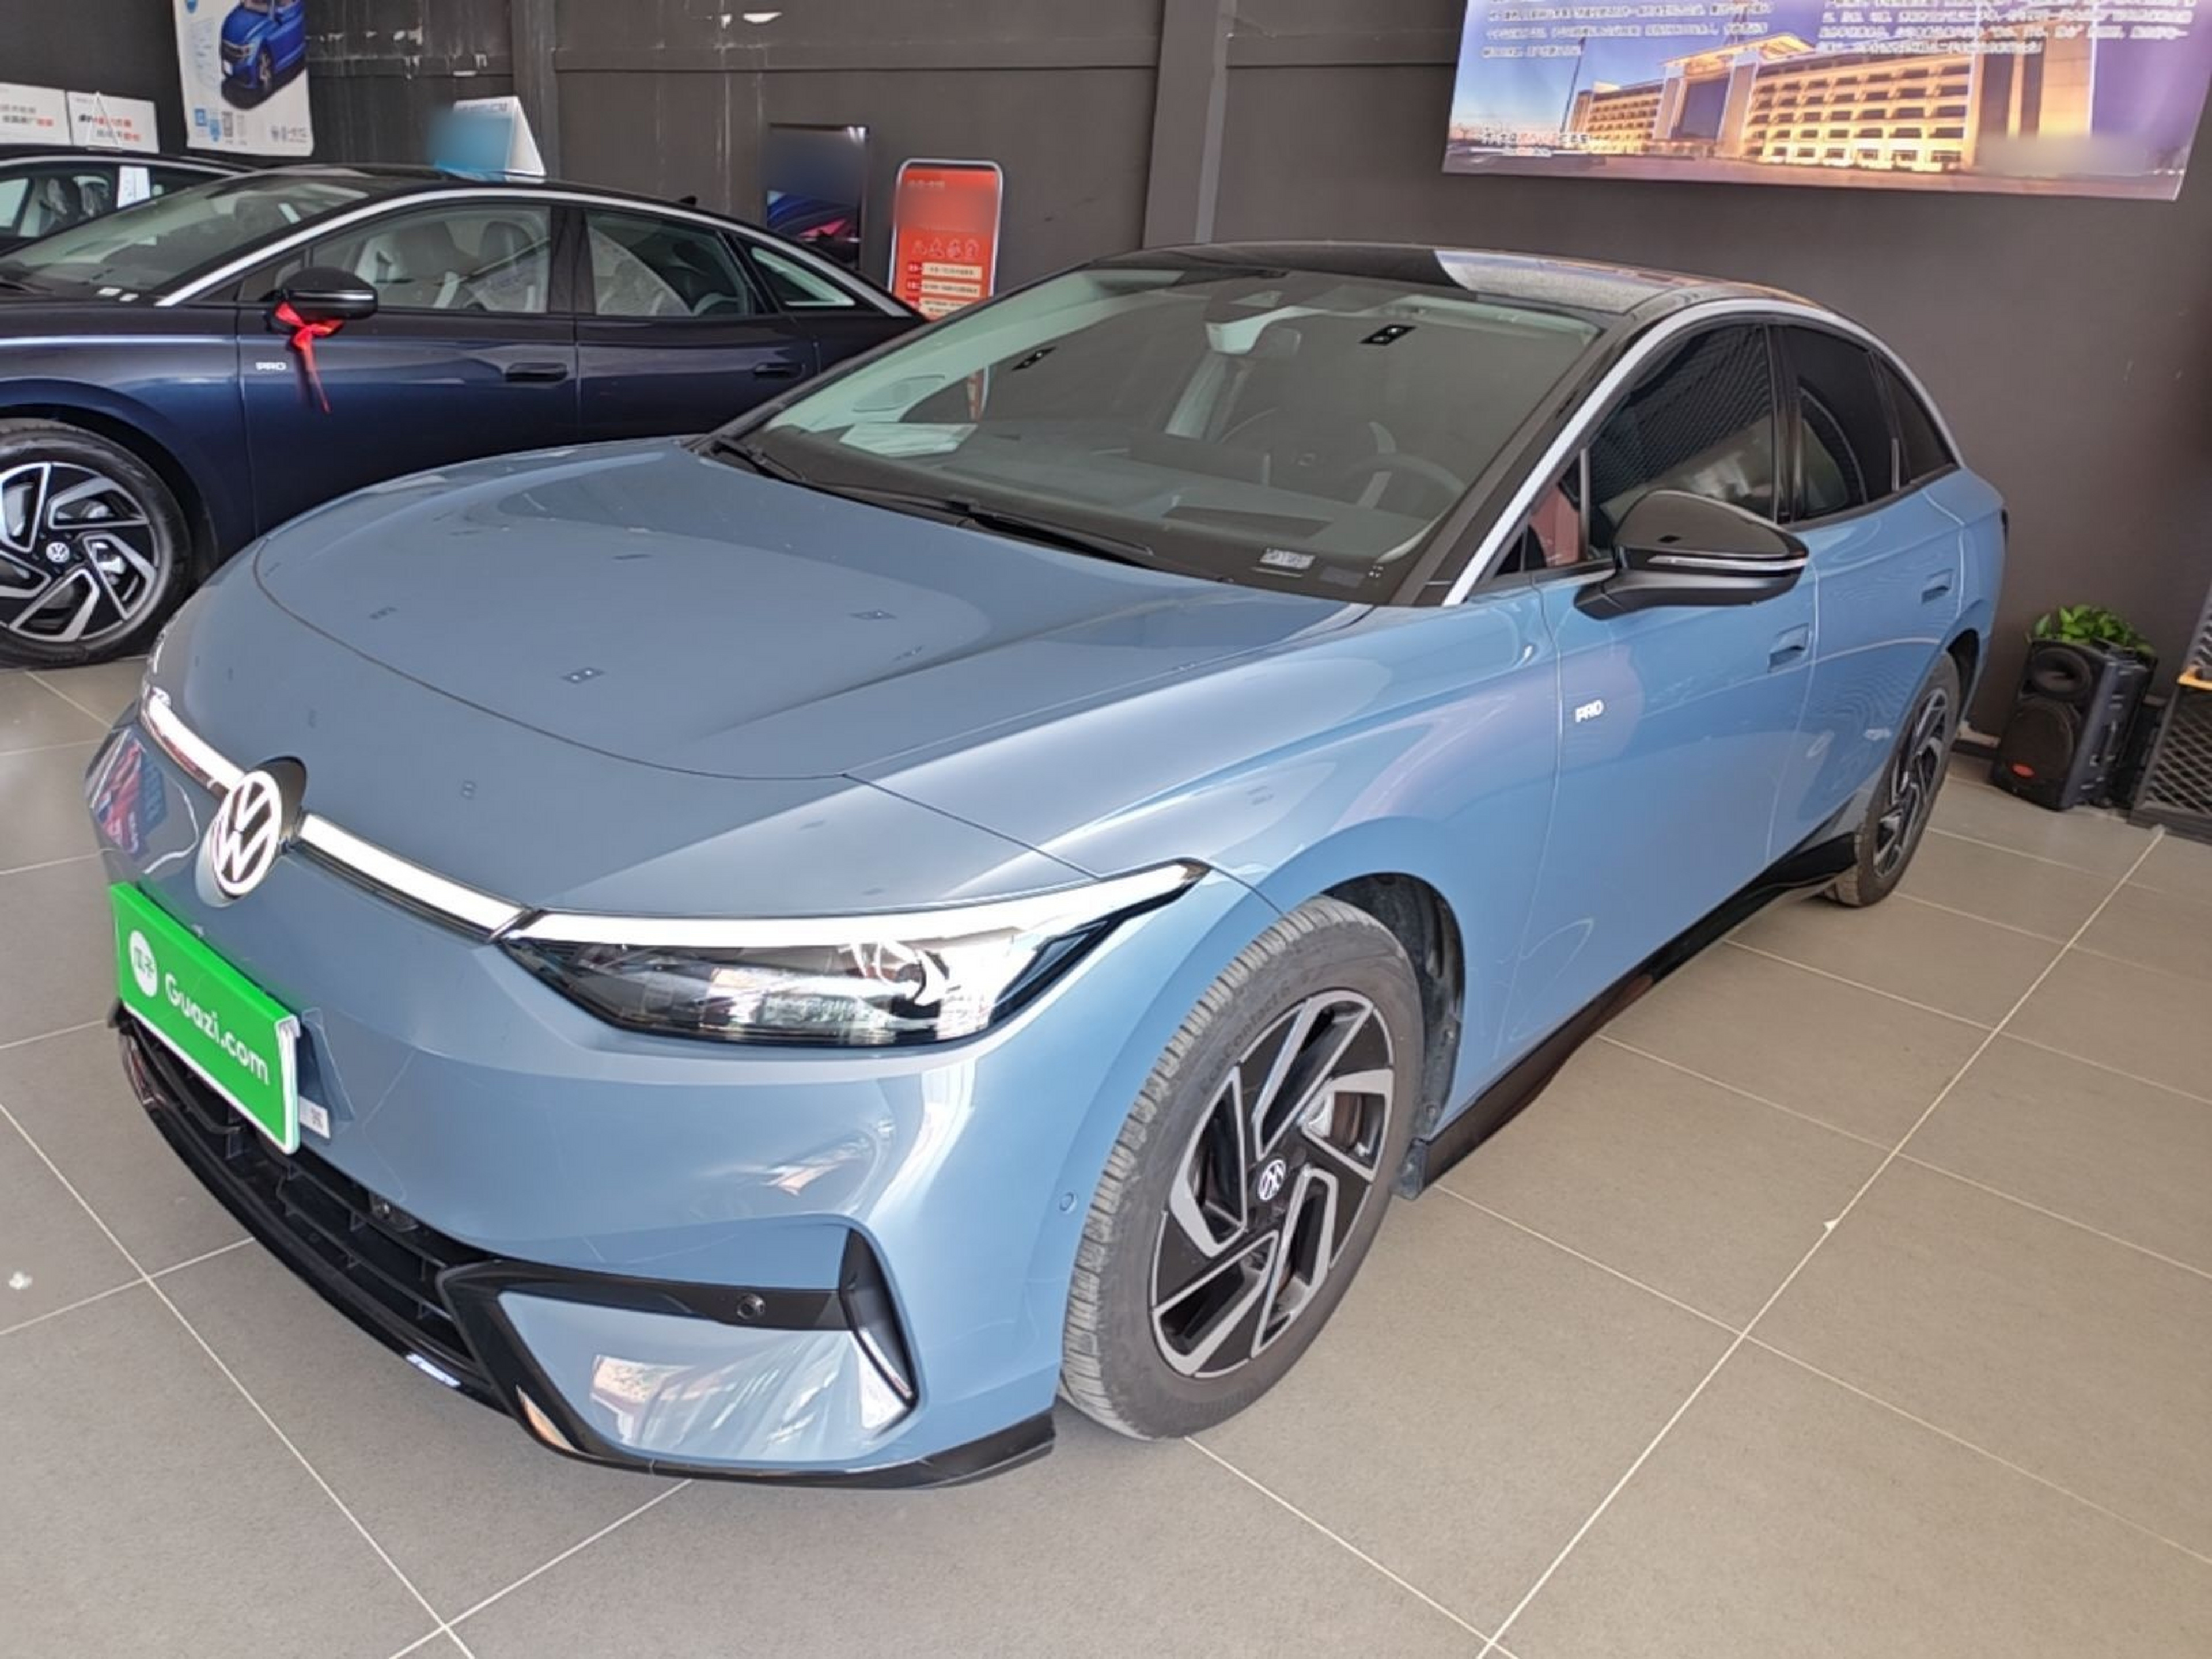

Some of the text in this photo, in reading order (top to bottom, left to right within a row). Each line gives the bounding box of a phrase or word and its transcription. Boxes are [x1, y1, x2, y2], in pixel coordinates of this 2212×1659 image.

[255, 362, 286, 370] PRO
[1575, 700, 1604, 722] PRO
[165, 972, 270, 1085] Guazi.com
